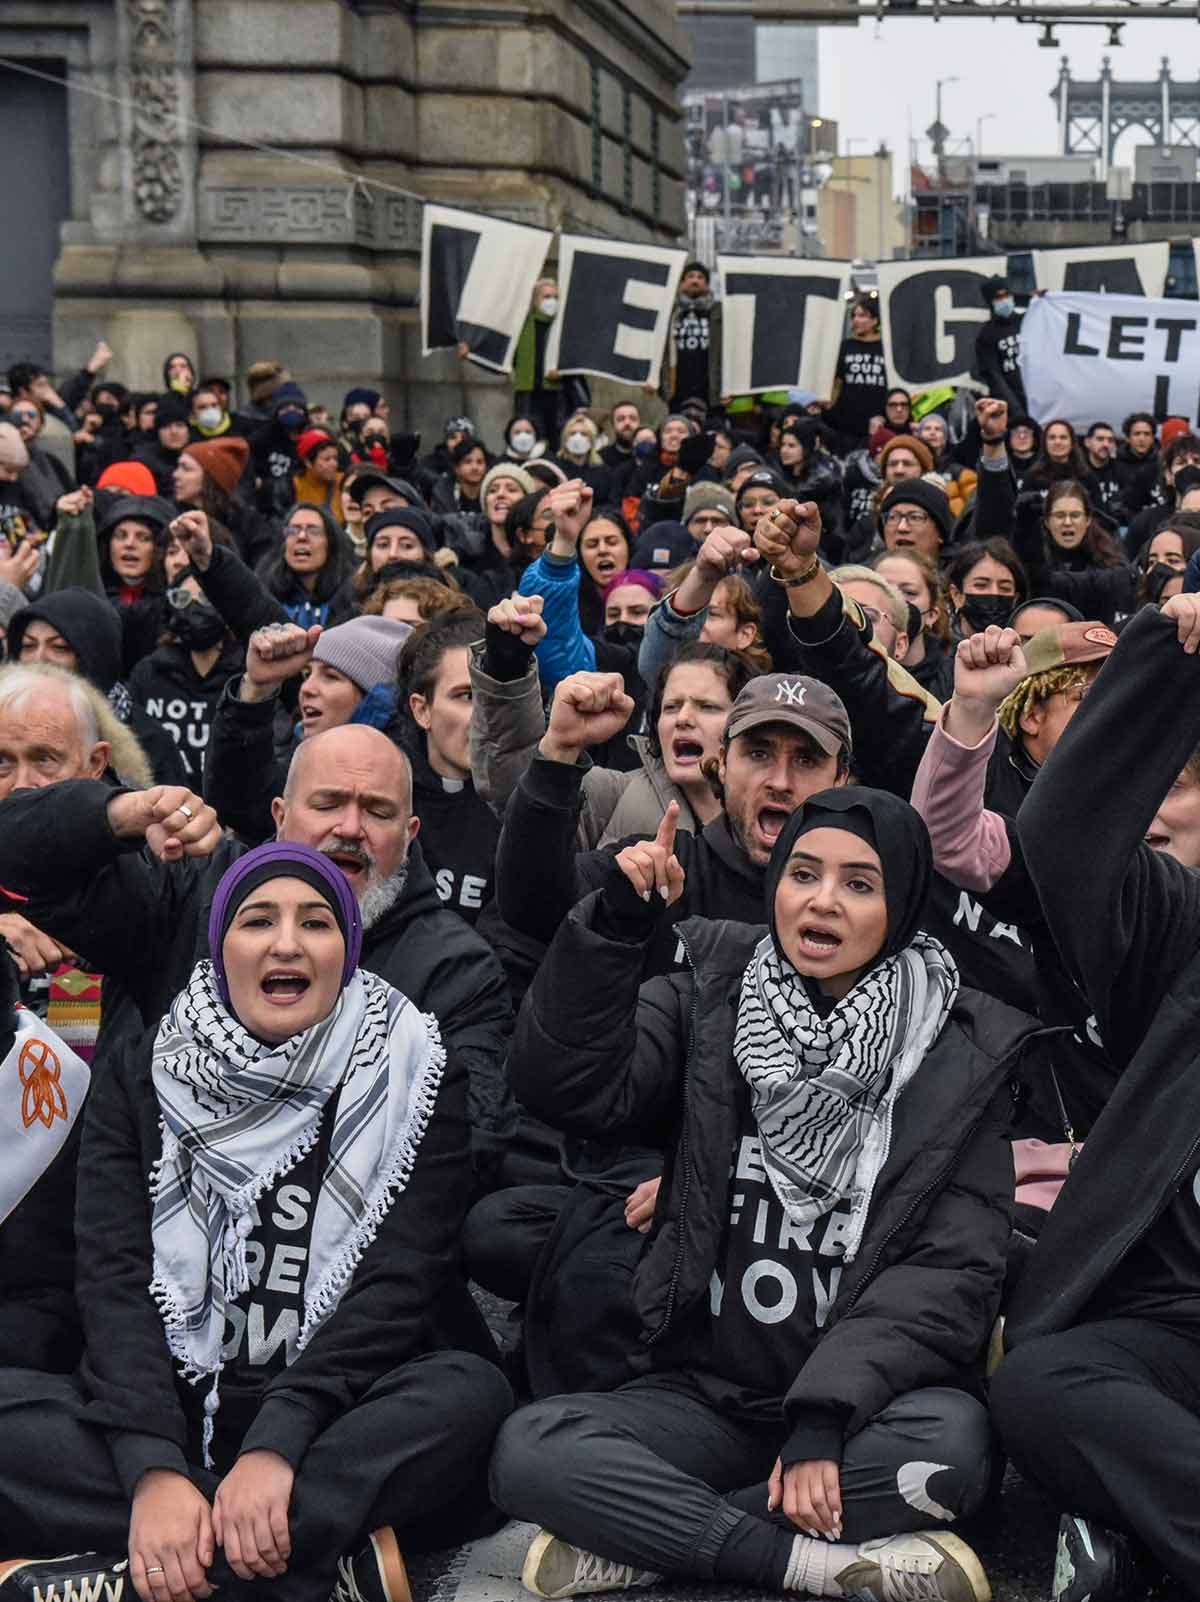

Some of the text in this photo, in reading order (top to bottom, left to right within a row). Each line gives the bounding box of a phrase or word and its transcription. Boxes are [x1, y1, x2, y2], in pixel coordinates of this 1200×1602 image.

[1063, 312, 1197, 362] LET
[845, 353, 871, 364] NOT
[849, 363, 882, 374] OUR
[146, 698, 208, 720] NOT
